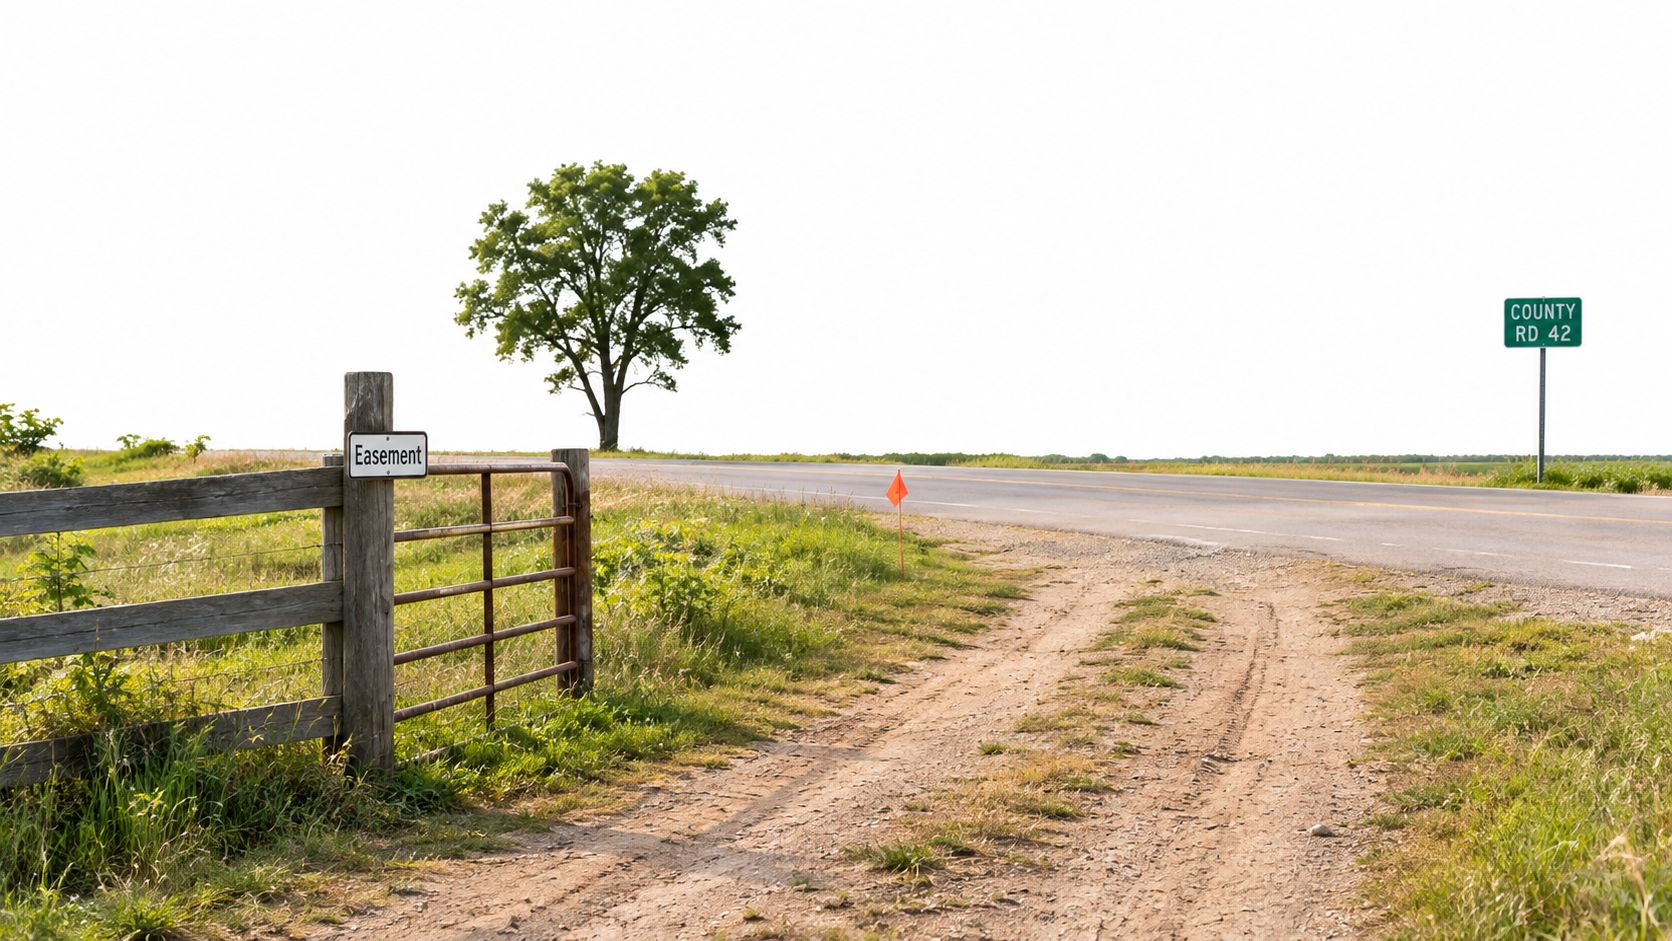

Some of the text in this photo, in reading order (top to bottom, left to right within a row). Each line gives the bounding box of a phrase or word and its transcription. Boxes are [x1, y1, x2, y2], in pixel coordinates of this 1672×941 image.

[1511, 303, 1576, 320] COUNTY
[1515, 324, 1571, 342] RD 42
[355, 444, 422, 466] Easement
